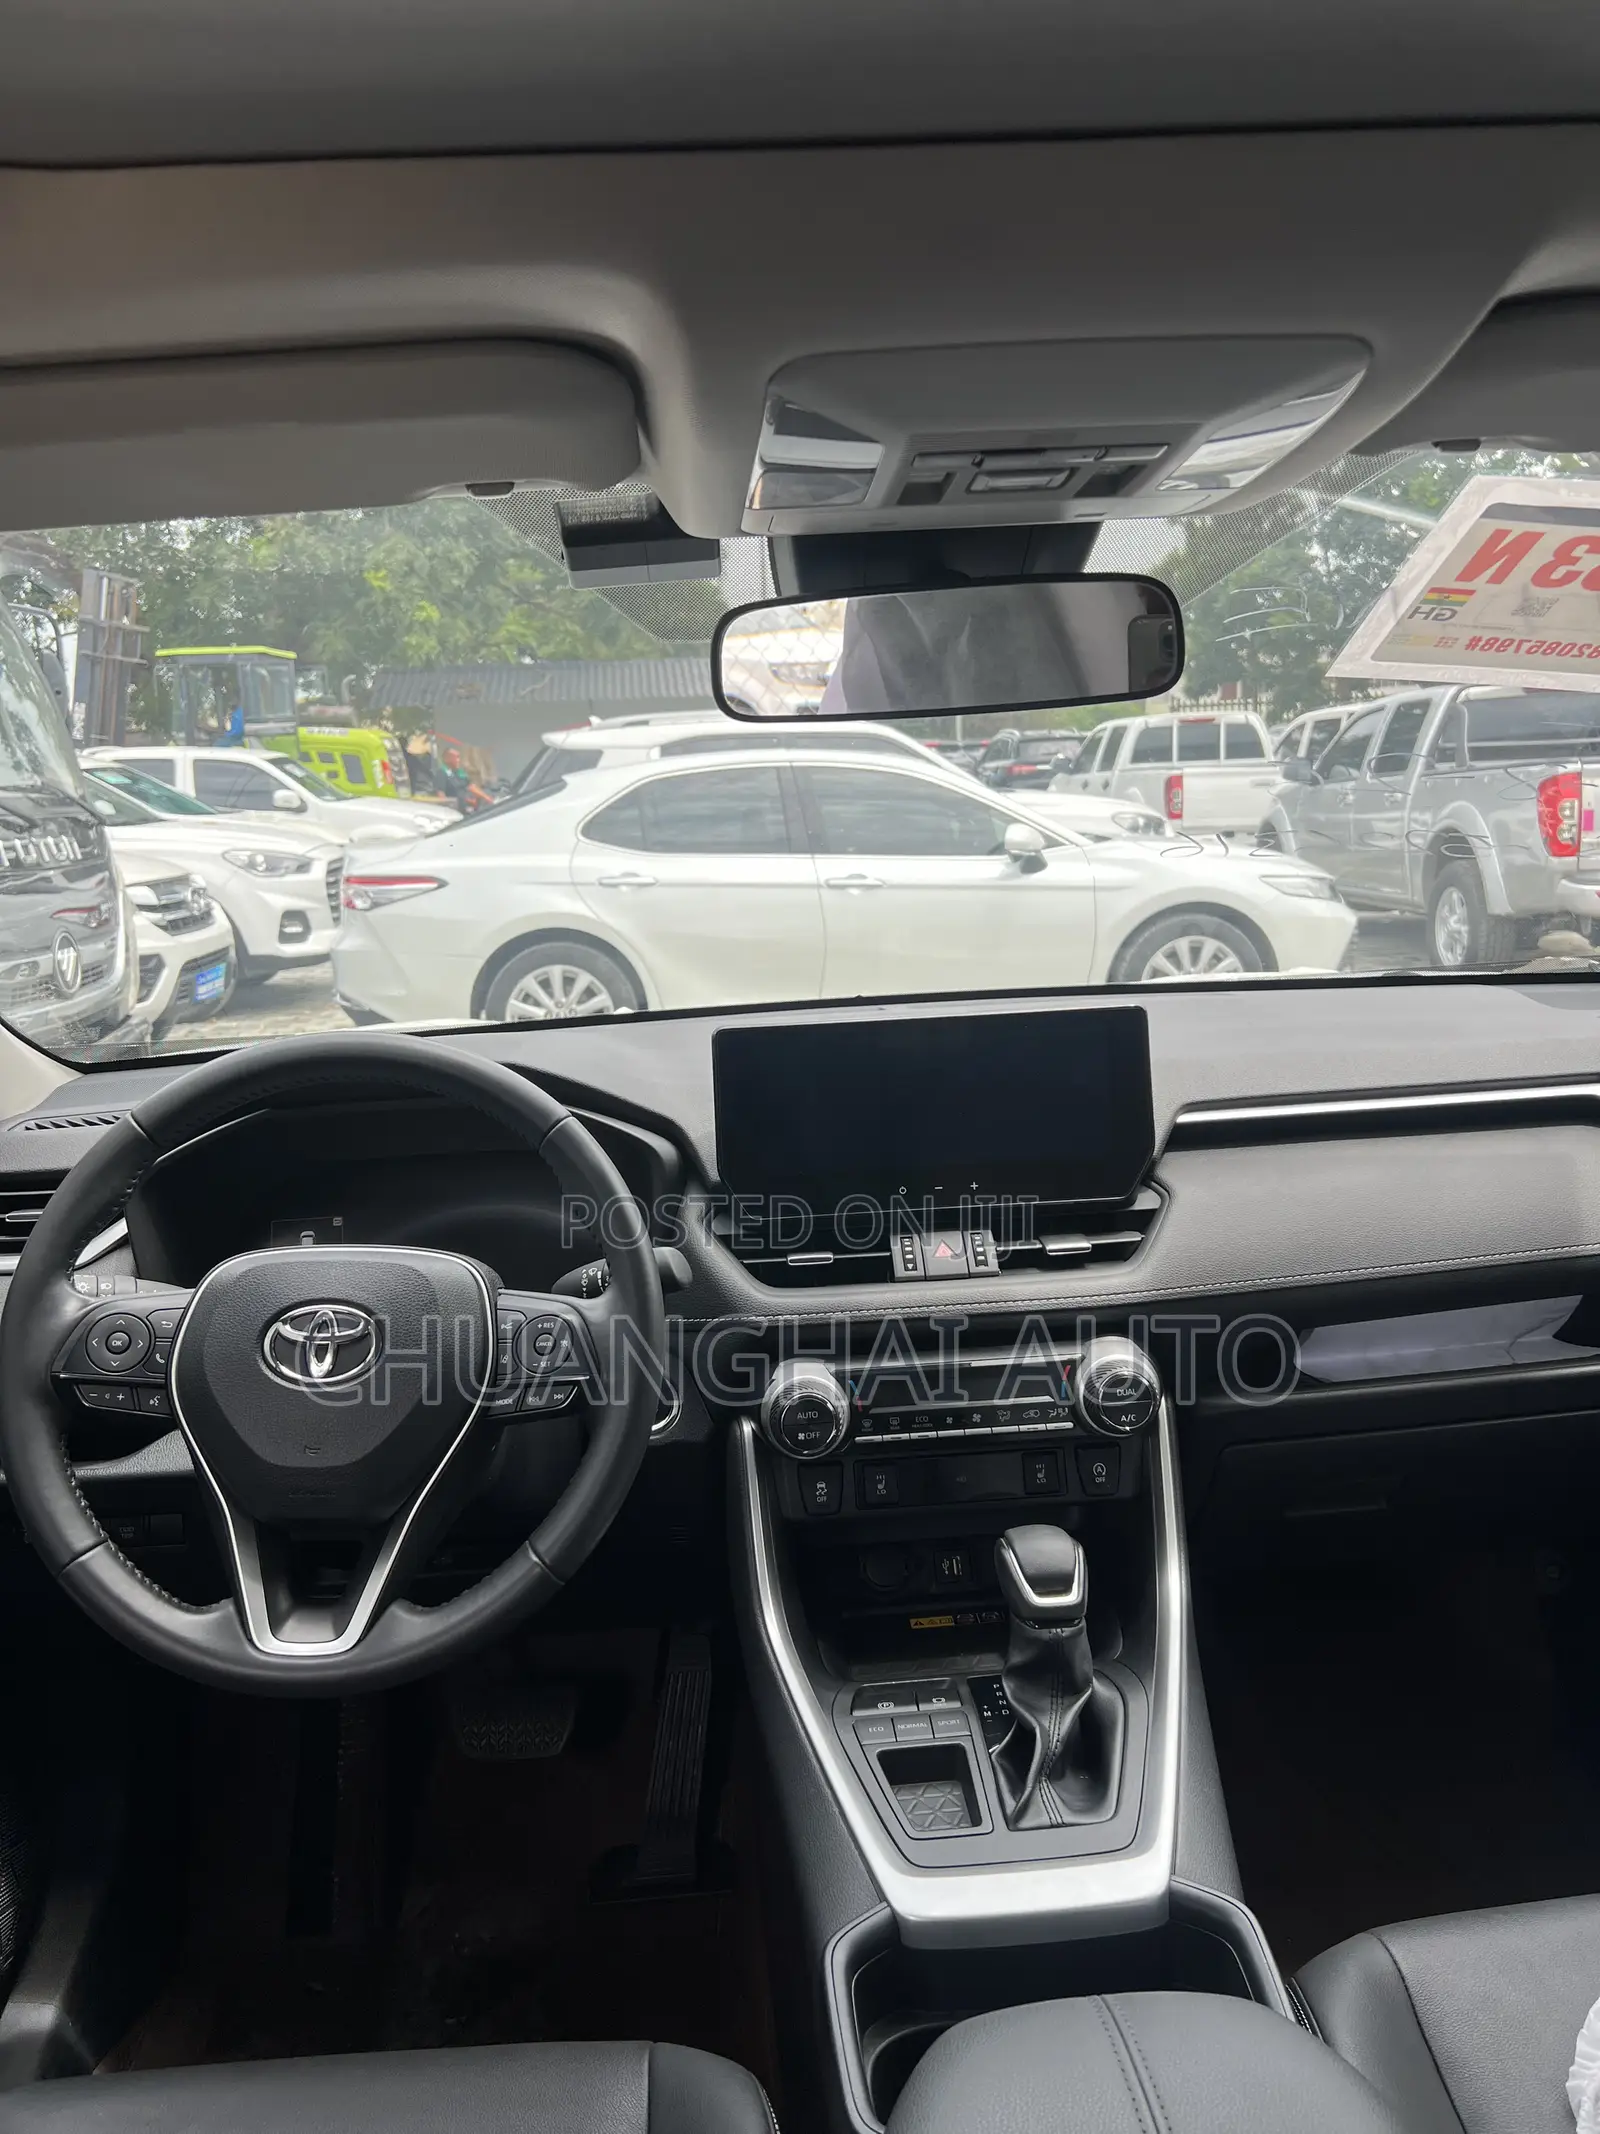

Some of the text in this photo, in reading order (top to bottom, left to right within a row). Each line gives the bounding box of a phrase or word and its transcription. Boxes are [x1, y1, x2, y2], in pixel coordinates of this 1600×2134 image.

[1116, 1389, 1137, 1397] DUAL
[797, 1410, 819, 1419] AUTO
[915, 1415, 929, 1423] ECO
[1120, 1414, 1137, 1423] A/C
[805, 1431, 821, 1440] OFF
[897, 1721, 928, 1730] NORMAL
